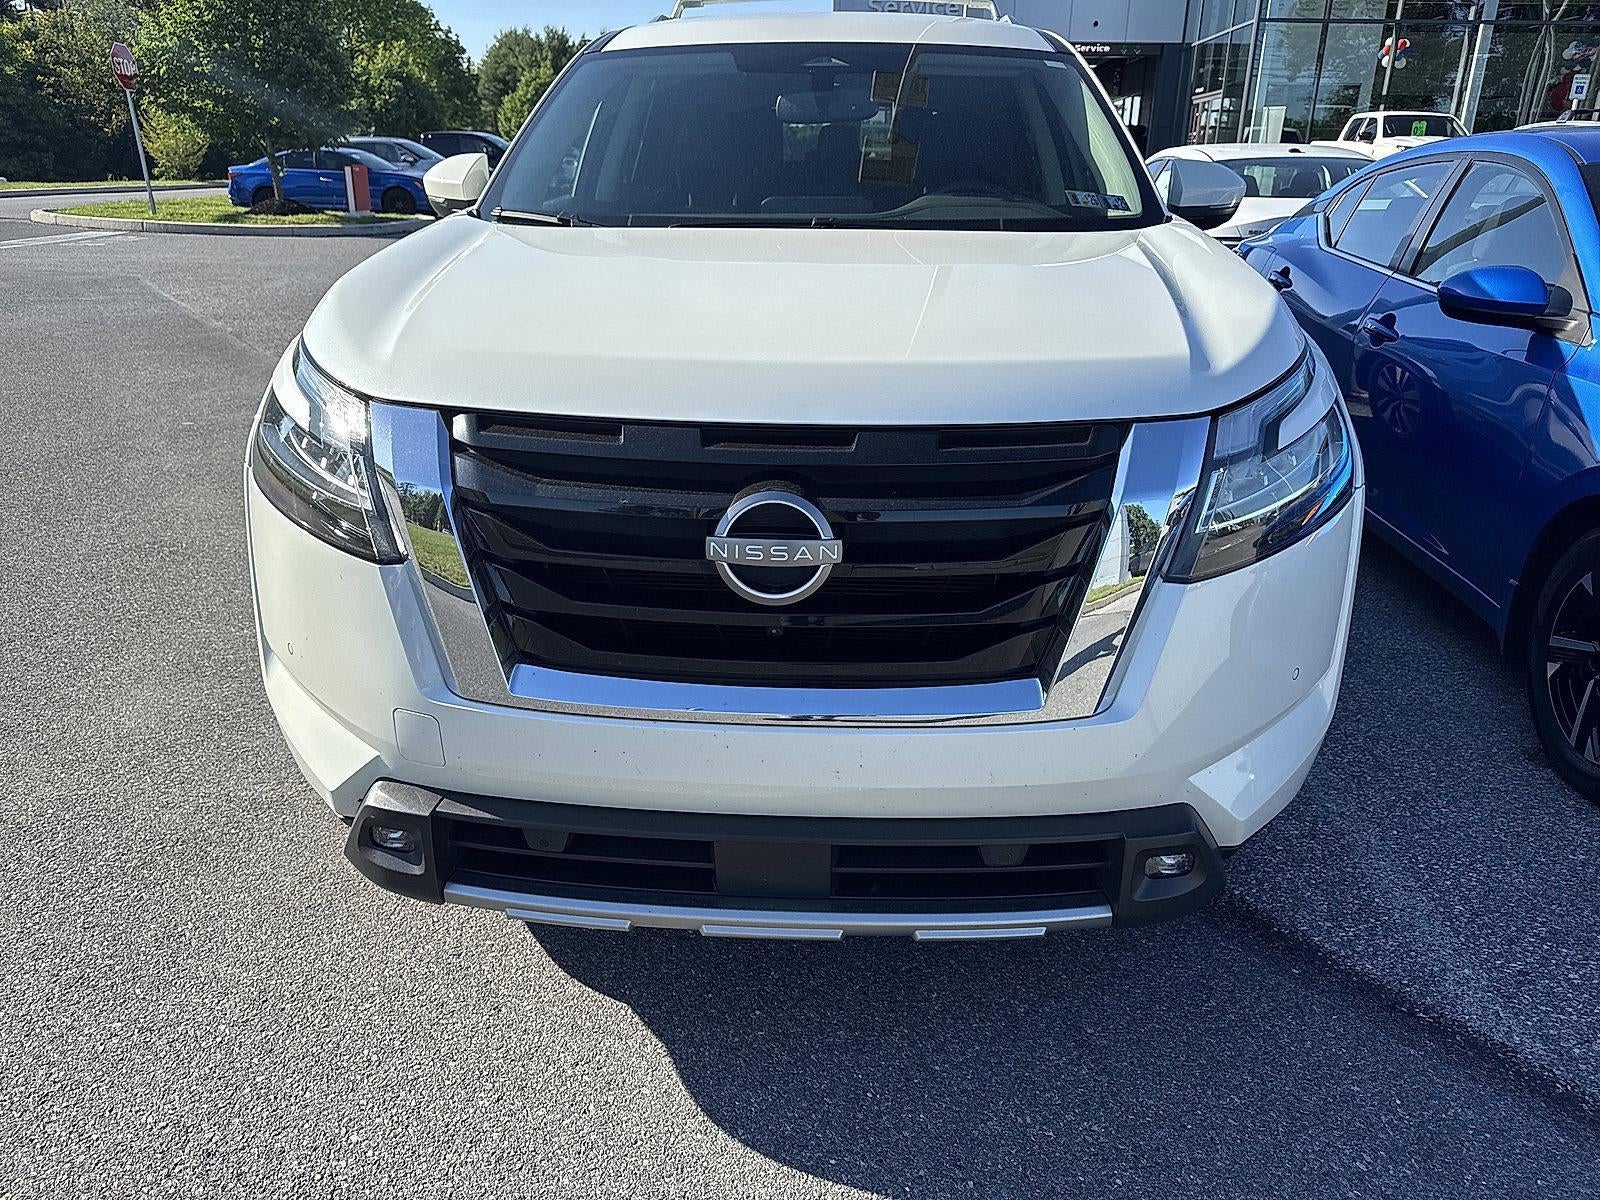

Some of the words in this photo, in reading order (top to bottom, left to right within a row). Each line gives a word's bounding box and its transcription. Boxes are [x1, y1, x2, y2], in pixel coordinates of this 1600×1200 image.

[868, 0, 961, 16] Service
[1075, 43, 1111, 53] Service
[113, 56, 136, 76] STOP
[710, 541, 838, 561] NISSAN
